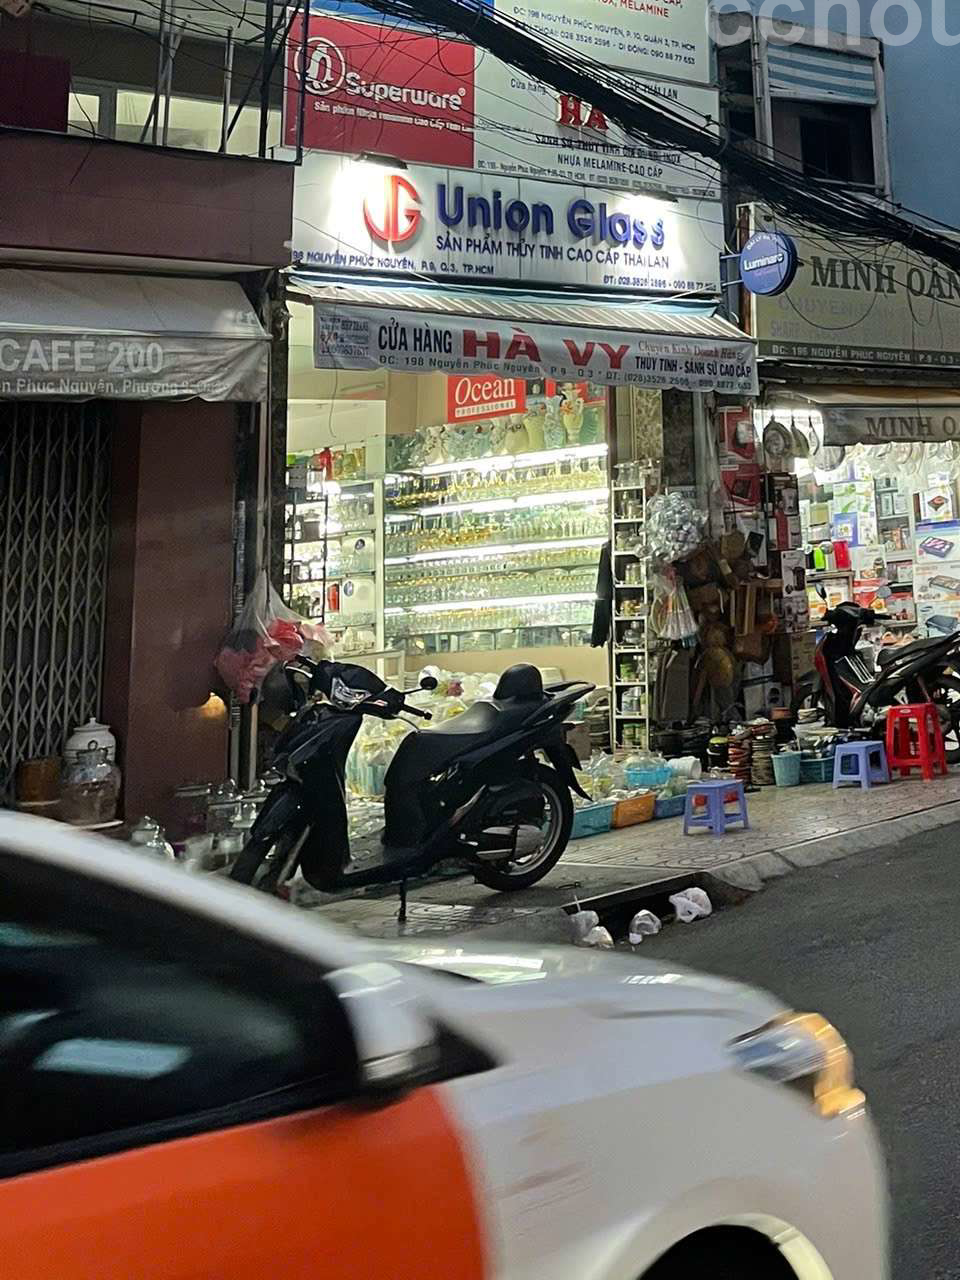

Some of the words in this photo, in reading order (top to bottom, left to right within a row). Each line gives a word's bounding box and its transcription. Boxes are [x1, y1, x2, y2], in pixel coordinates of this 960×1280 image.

[584, 157, 627, 173] MELAMINE
[628, 164, 645, 177] CAO
[437, 183, 555, 236] Union
[567, 199, 666, 250] Glass
[540, 245, 563, 261] TINH
[567, 247, 593, 263] CAO
[648, 255, 669, 269] LAN
[743, 253, 784, 271] Luminarc
[462, 263, 494, 275] TP.HCM
[810, 255, 896, 294] MINH
[378, 317, 408, 352] CỬA
[413, 322, 452, 353] HÀNG
[463, 326, 542, 362] HÀ
[563, 338, 631, 369] VY
[107, 341, 164, 374] 200
[380, 355, 400, 365] ĐC:
[405, 357, 424, 366] 198
[659, 358, 677, 372] TINH
[720, 363, 735, 377] CAO
[455, 378, 516, 405] Ocean
[865, 416, 935, 438] MINH
